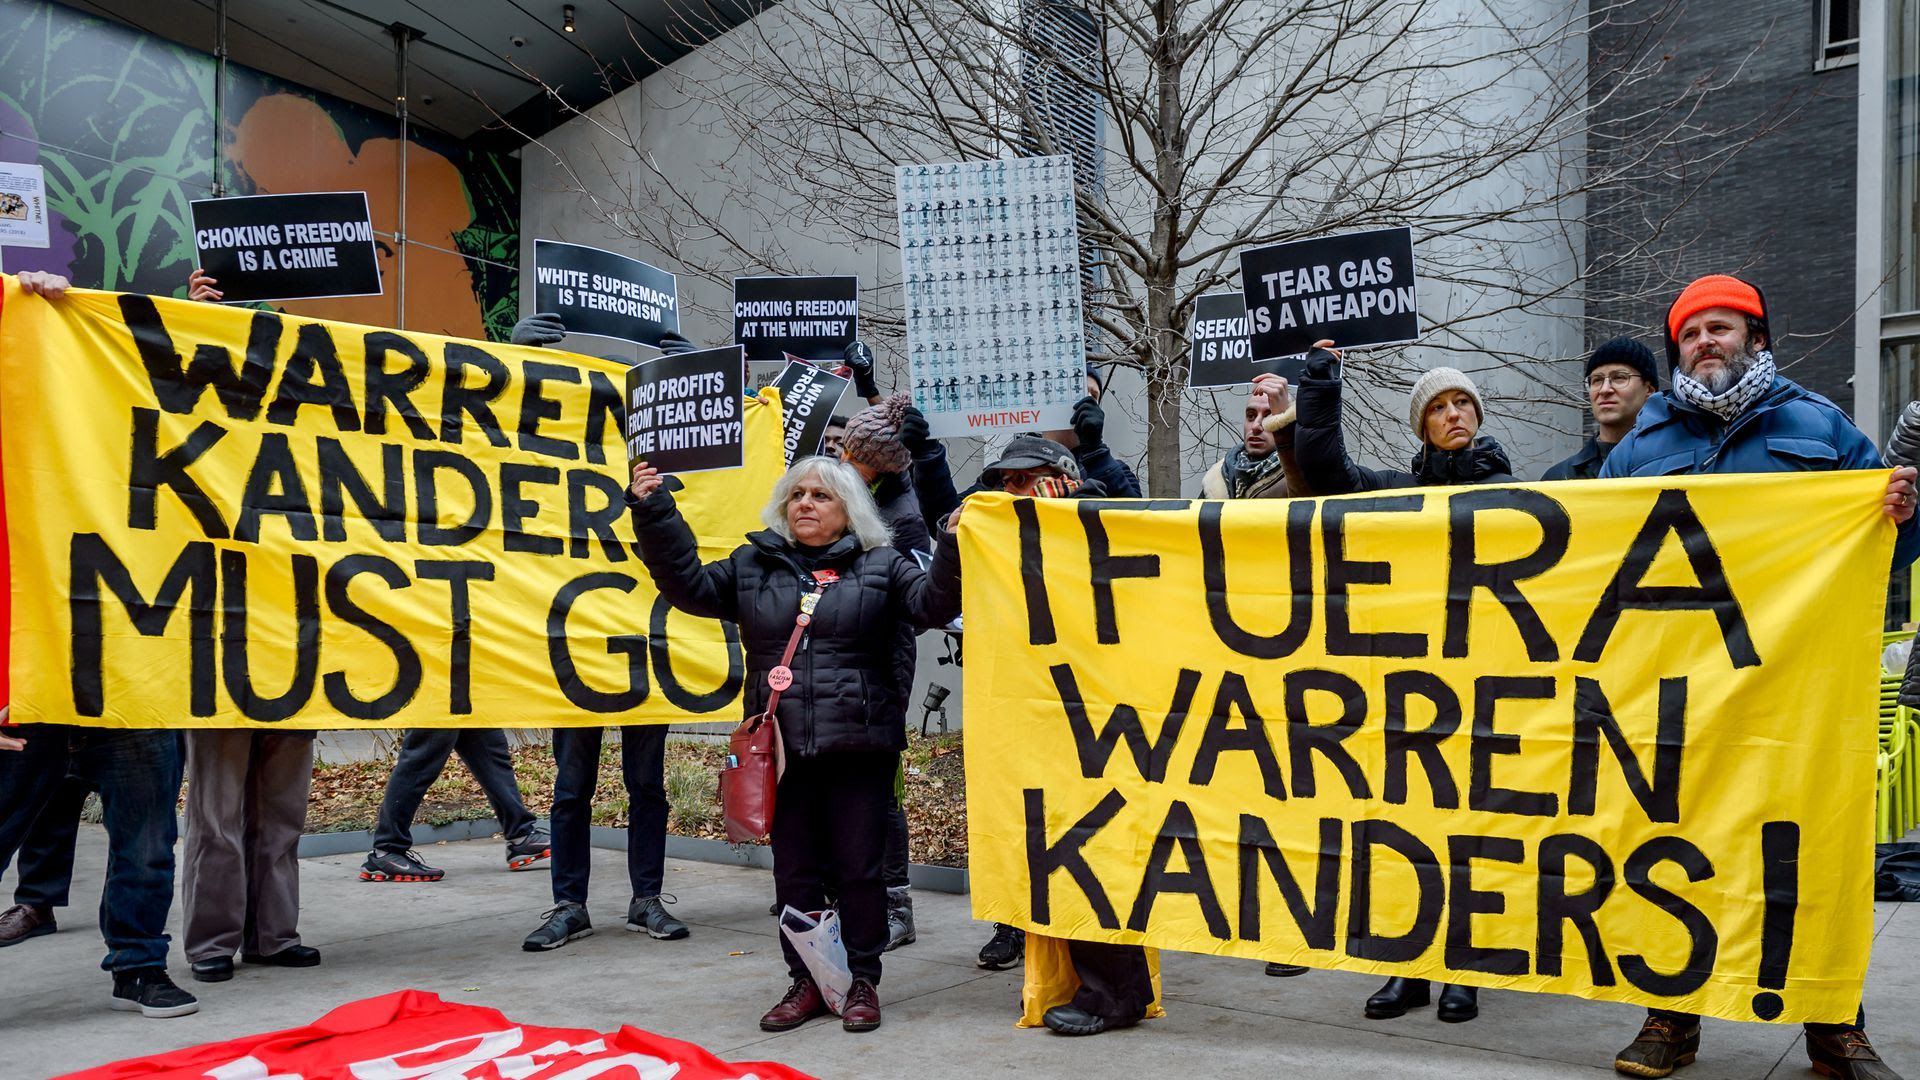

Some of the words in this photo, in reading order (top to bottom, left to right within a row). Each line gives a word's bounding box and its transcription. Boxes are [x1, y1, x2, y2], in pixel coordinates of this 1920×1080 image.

[32, 196, 42, 224] WHITNEY
[196, 224, 281, 250] CHOKING
[283, 221, 372, 245] FREEDOM
[238, 251, 258, 272] IS
[262, 249, 277, 271] A
[279, 246, 339, 270] CRIME
[537, 266, 589, 289] WHITE
[592, 274, 675, 311] SUPREMACY
[1261, 264, 1333, 300] TEAR
[1338, 256, 1394, 289] GAS
[558, 287, 574, 306] IS
[577, 290, 662, 323] TERRORISM
[735, 300, 792, 318] CHOKING
[795, 299, 856, 317] FREEDOM
[1247, 305, 1272, 335] IS
[1279, 302, 1297, 330] A
[1301, 285, 1416, 326] WEAPON
[741, 321, 758, 338] AT
[760, 321, 787, 337] THE
[789, 320, 848, 337] WHITNEY
[1200, 341, 1217, 362] IS
[632, 382, 656, 409] WHO
[658, 371, 724, 401] PROFITS
[784, 366, 819, 406] FROM
[796, 382, 825, 417] WHO
[628, 407, 653, 436] FROM
[655, 400, 697, 426] TEAR
[700, 396, 735, 421] GAS
[967, 410, 1041, 428] WHITNEY
[635, 431, 655, 457] THE
[658, 421, 742, 451] WHITNEY?
[69, 531, 495, 722] MUST
[546, 571, 744, 714] GO
[1049, 662, 1689, 825] WARREN
[1022, 786, 1799, 1022] KANDERS!
